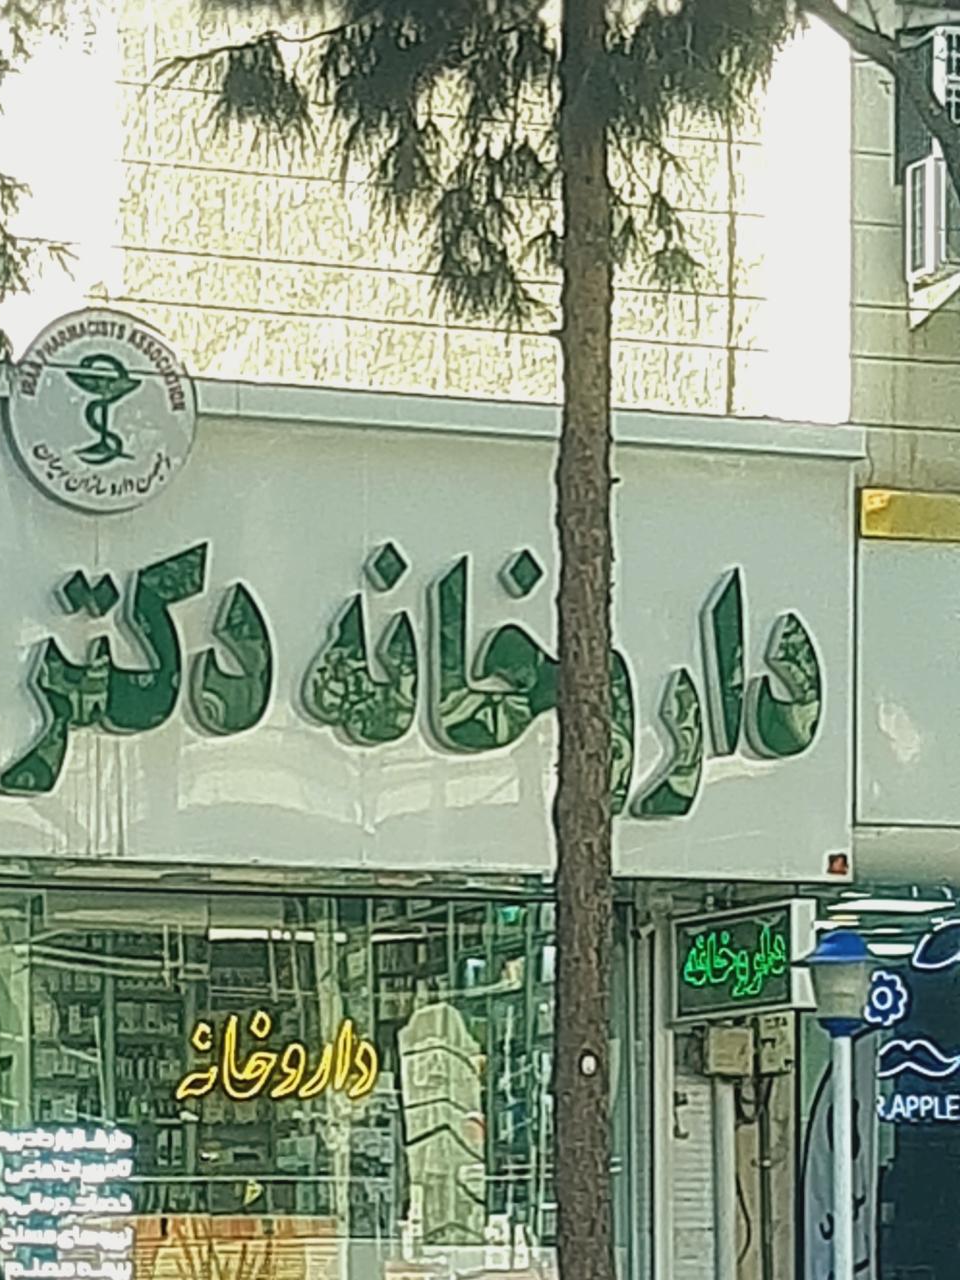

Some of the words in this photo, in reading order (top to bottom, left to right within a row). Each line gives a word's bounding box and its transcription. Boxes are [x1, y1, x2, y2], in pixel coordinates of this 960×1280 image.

[684, 924, 786, 997] داروخانه
[176, 1010, 378, 1100] داروخانه
[886, 1093, 960, 1120] APPLE
